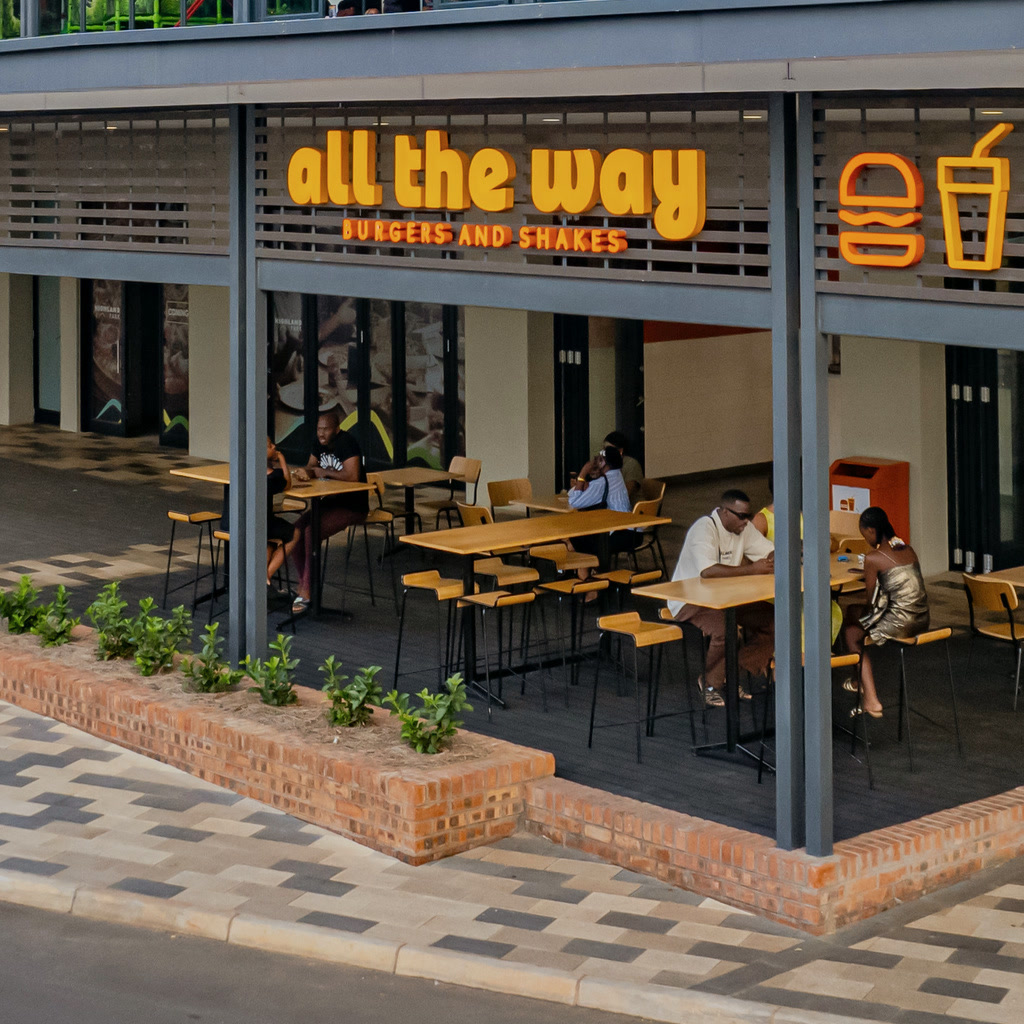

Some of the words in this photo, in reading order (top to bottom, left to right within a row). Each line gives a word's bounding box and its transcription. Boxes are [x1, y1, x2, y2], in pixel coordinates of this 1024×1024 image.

[288, 130, 383, 207] all
[394, 130, 517, 212] the
[531, 147, 706, 241] way
[342, 218, 453, 245] BURGERS
[458, 224, 513, 248] AND
[519, 226, 629, 253] SHAKES
